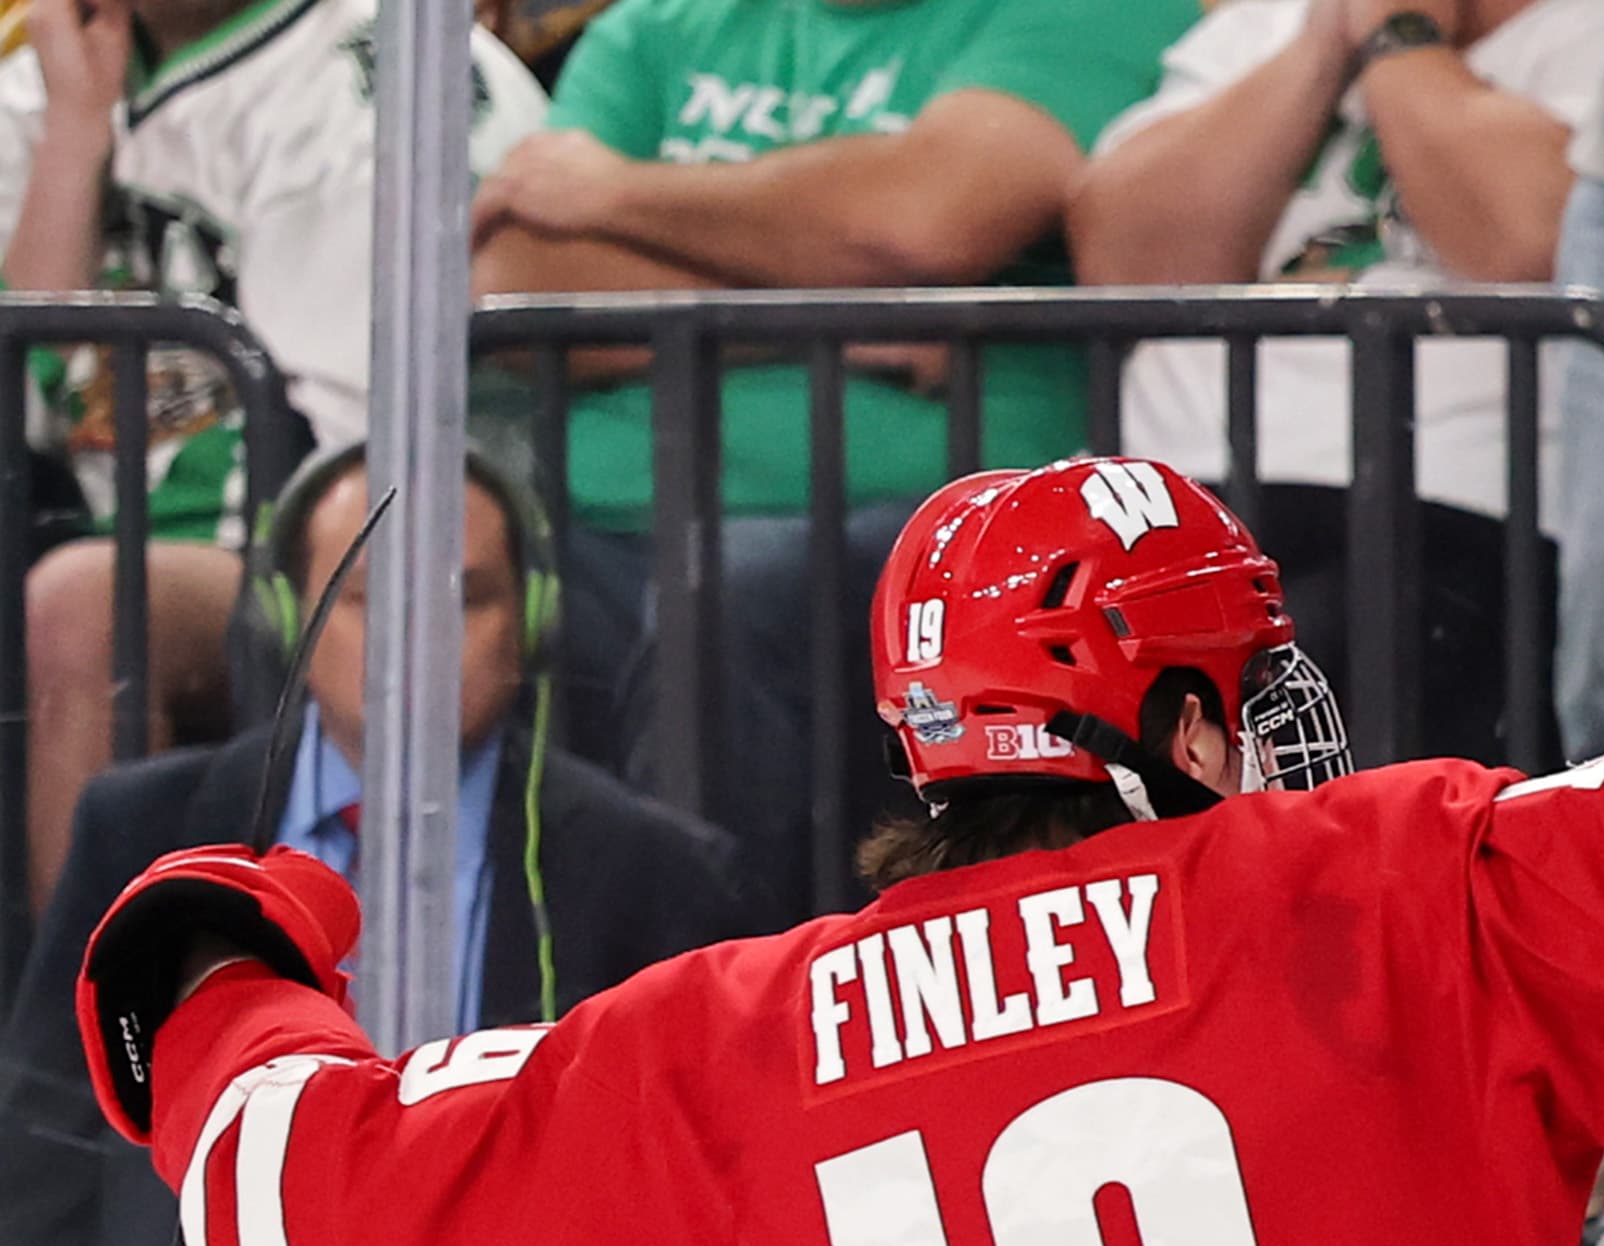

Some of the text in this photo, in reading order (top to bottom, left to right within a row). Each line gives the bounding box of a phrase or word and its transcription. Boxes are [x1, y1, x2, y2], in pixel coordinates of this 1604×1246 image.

[1080, 461, 1180, 552] W
[906, 599, 945, 662] 19
[1257, 709, 1294, 736] CCM
[808, 873, 1160, 1086] FINLEY
